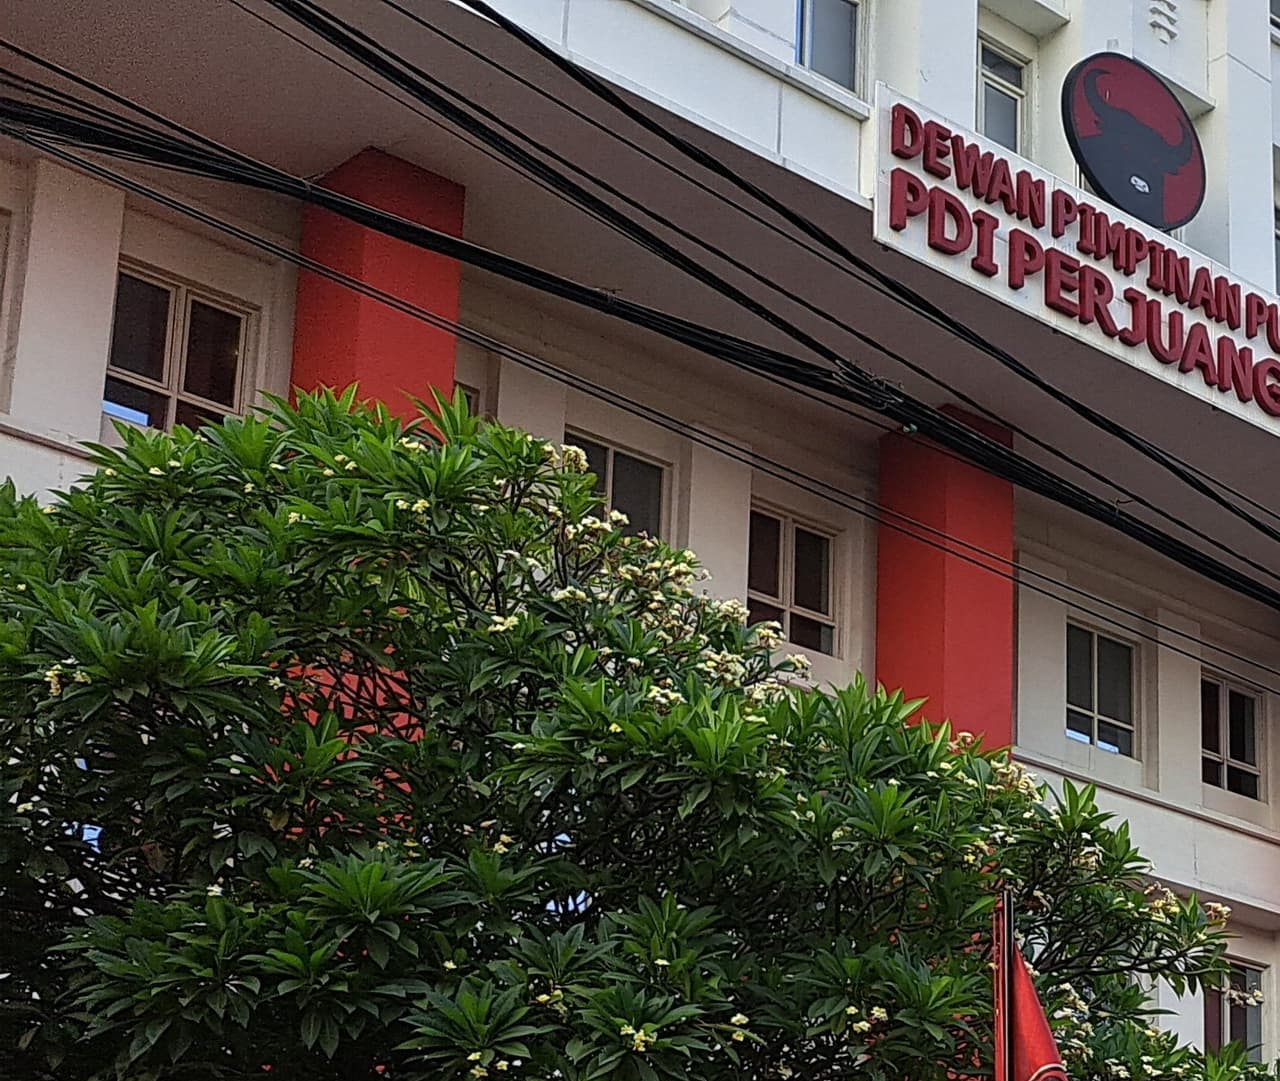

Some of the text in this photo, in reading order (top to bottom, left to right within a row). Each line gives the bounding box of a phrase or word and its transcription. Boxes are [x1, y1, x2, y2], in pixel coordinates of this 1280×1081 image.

[889, 167, 999, 277] PDI
[891, 103, 1046, 229] DEWAN
[1052, 188, 1242, 331] PIMPINAN
